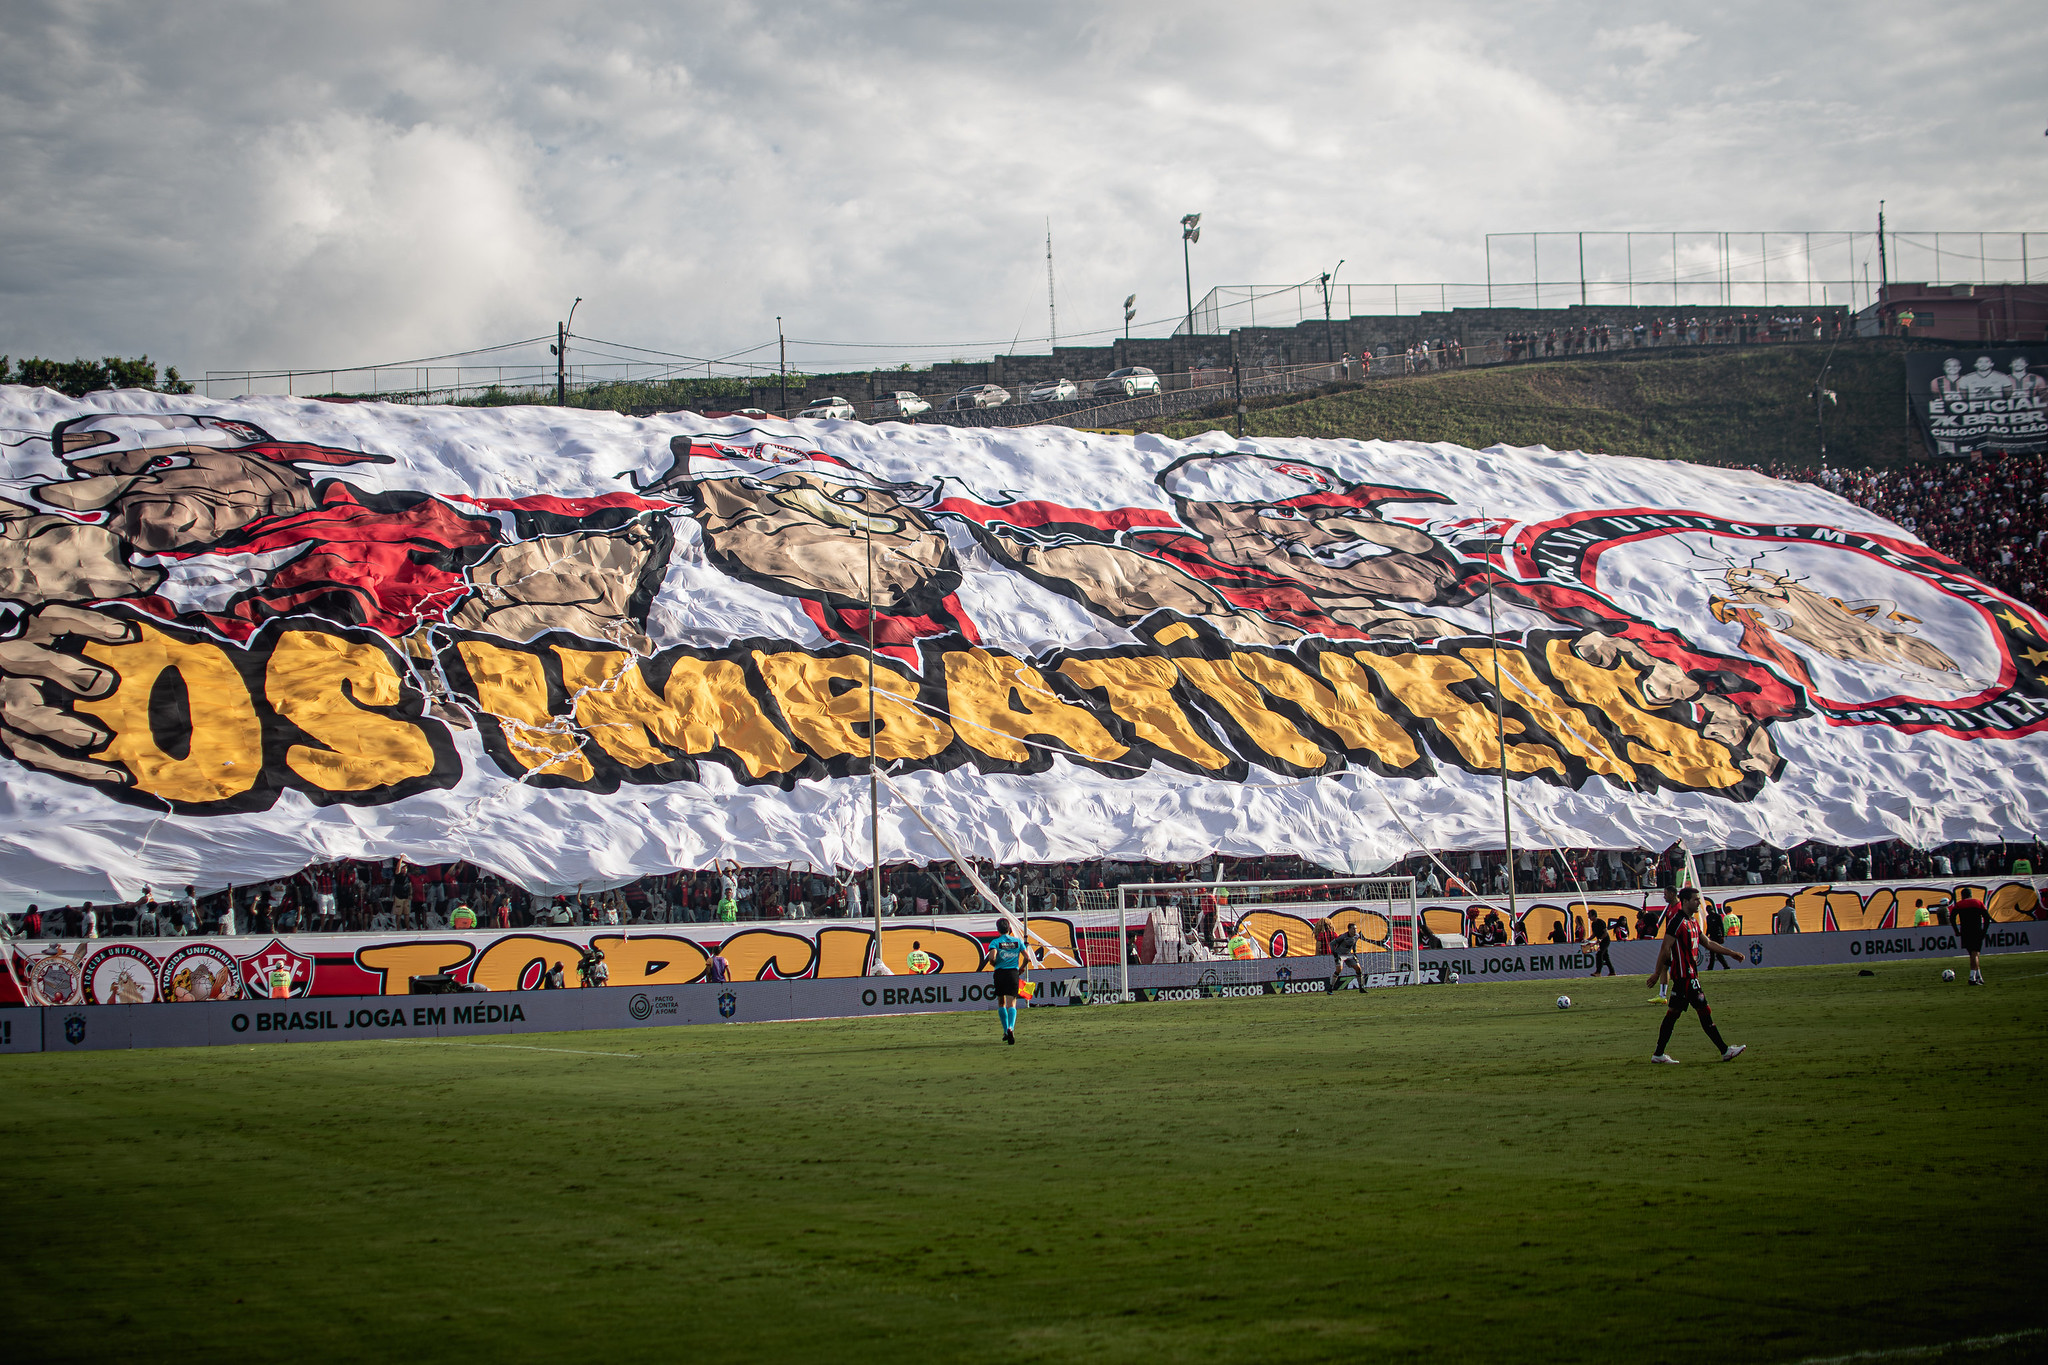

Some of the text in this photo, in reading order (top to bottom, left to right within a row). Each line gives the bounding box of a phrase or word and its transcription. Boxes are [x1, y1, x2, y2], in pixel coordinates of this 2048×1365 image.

[1929, 397, 2048, 414] É OFICIAL
[1929, 411, 2048, 427] 7K BETBR
[1931, 423, 2048, 437] CHEGOU AO LEÃO
[1851, 929, 2030, 956] O BRASIL JOGA MÉDIA
[163, 952, 186, 988] TORCIDA
[1480, 956, 1526, 974] JOGA
[1530, 955, 1554, 972] EM
[862, 989, 877, 1006] O
[883, 986, 952, 1005] BRASIL
[958, 984, 998, 1001] JOG
[1158, 987, 1200, 1001] SICOOB
[1222, 984, 1264, 998] SICOOB
[1284, 980, 1326, 995] SICOOB
[1092, 991, 1136, 1005] SICOB
[231, 1000, 526, 1032] O BRASIL JOGA EM MÉDIA
